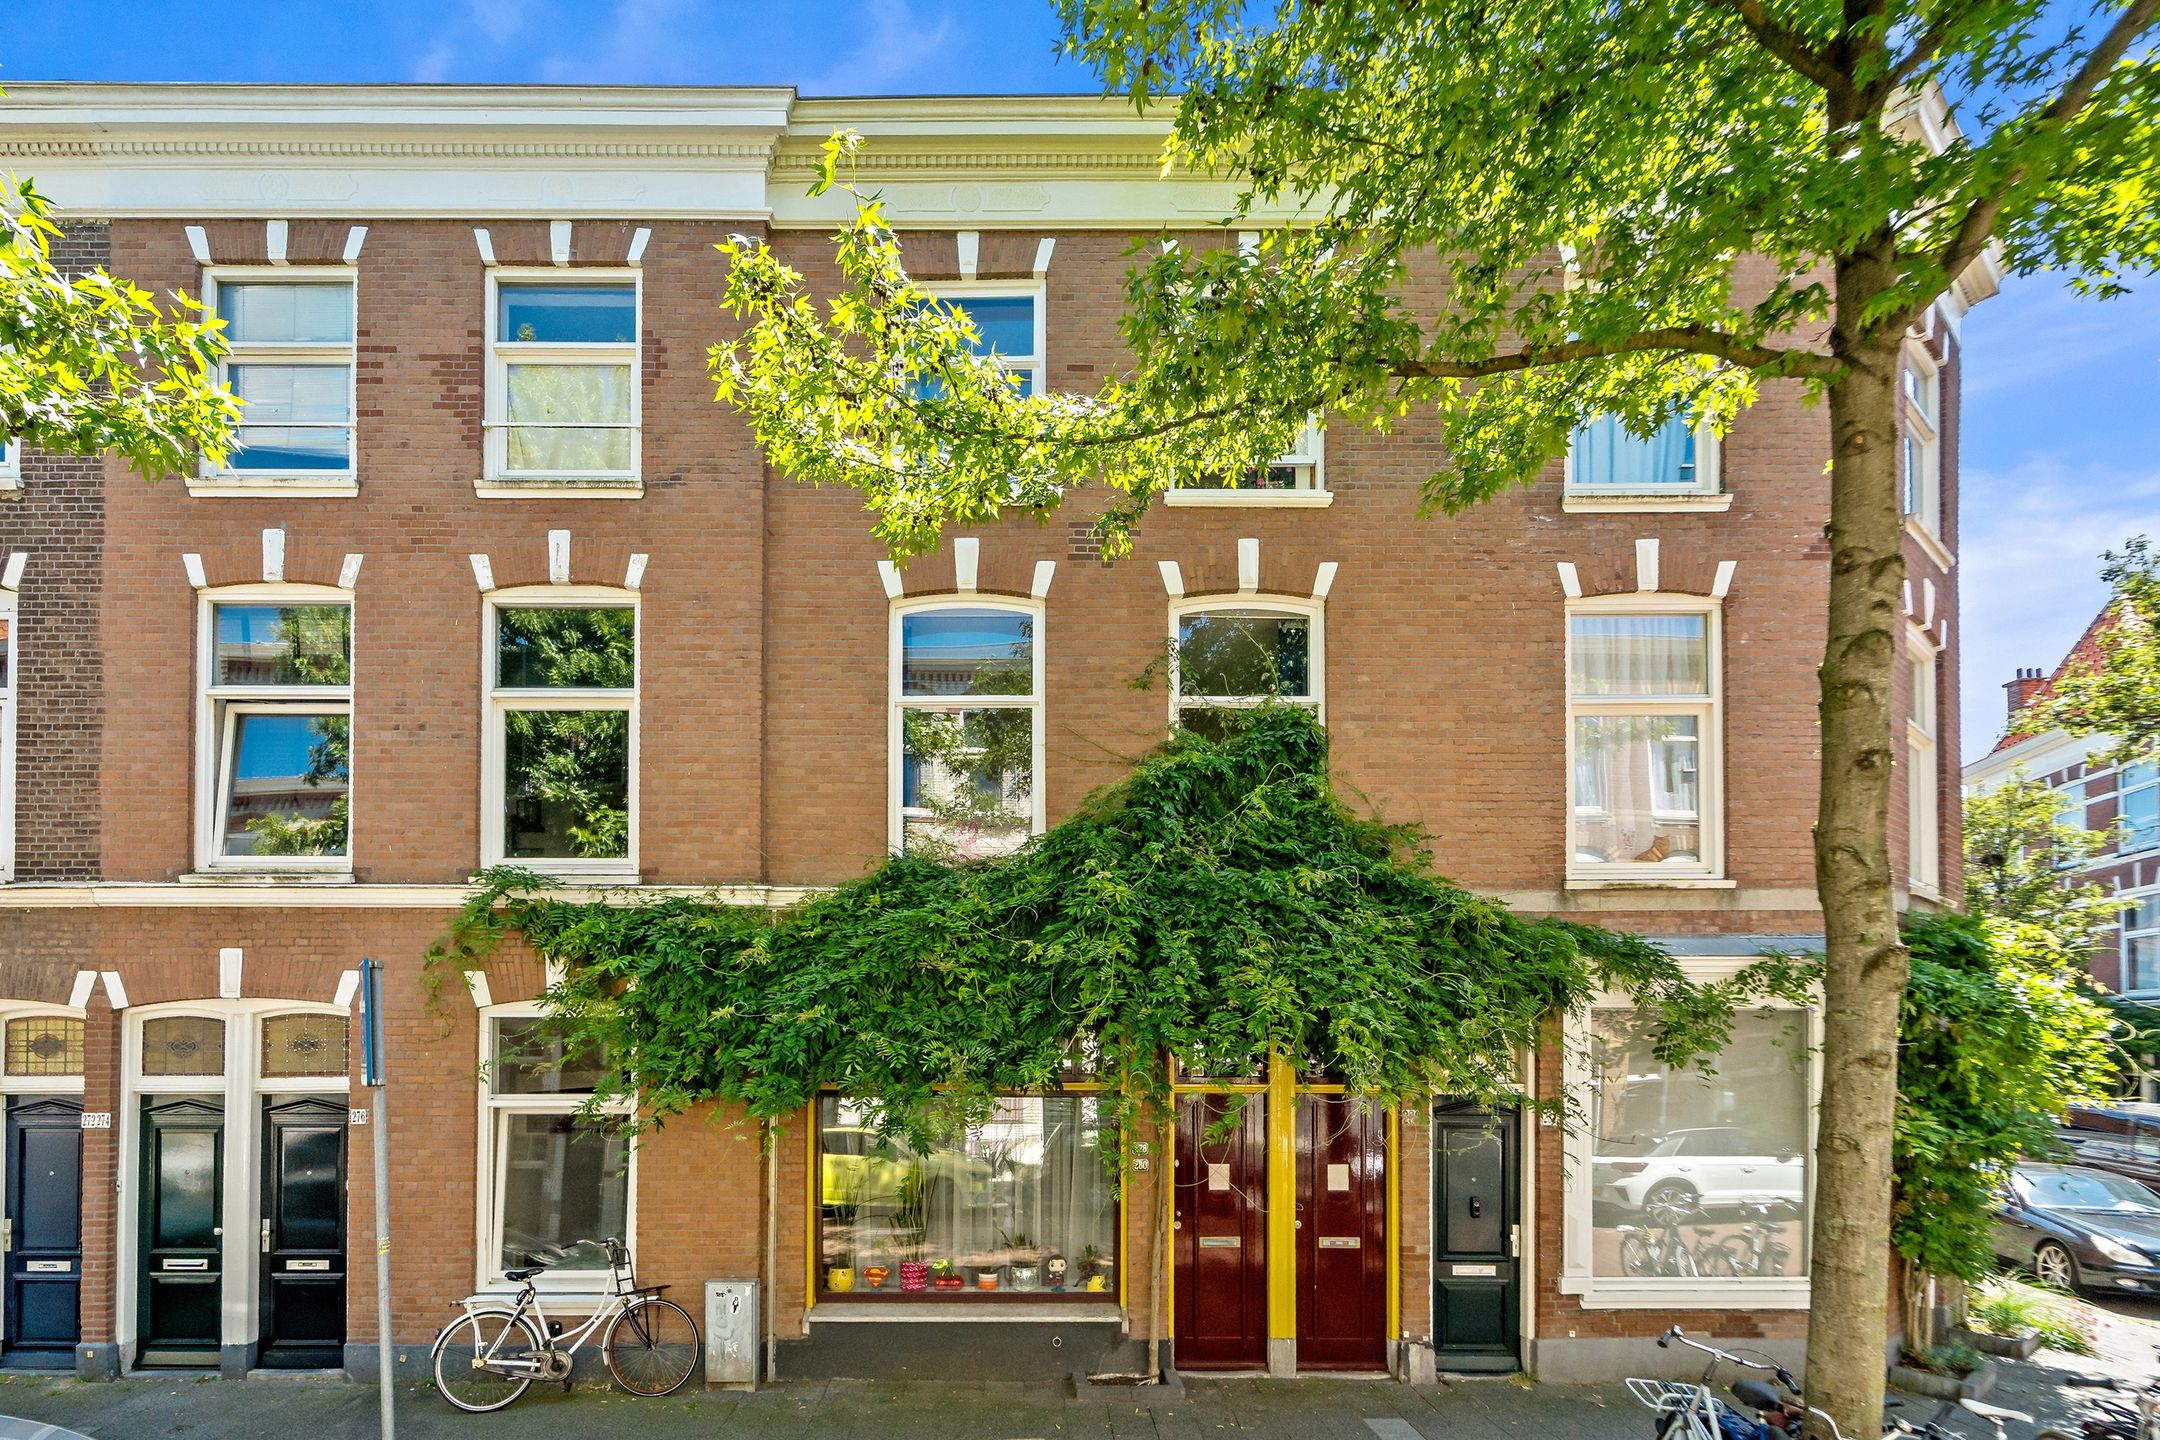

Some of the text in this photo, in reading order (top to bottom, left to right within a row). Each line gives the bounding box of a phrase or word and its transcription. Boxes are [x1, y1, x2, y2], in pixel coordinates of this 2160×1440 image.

[82, 1114, 110, 1127] 272 274
[352, 1110, 366, 1123] 276
[1134, 1160, 1148, 1170] 280
